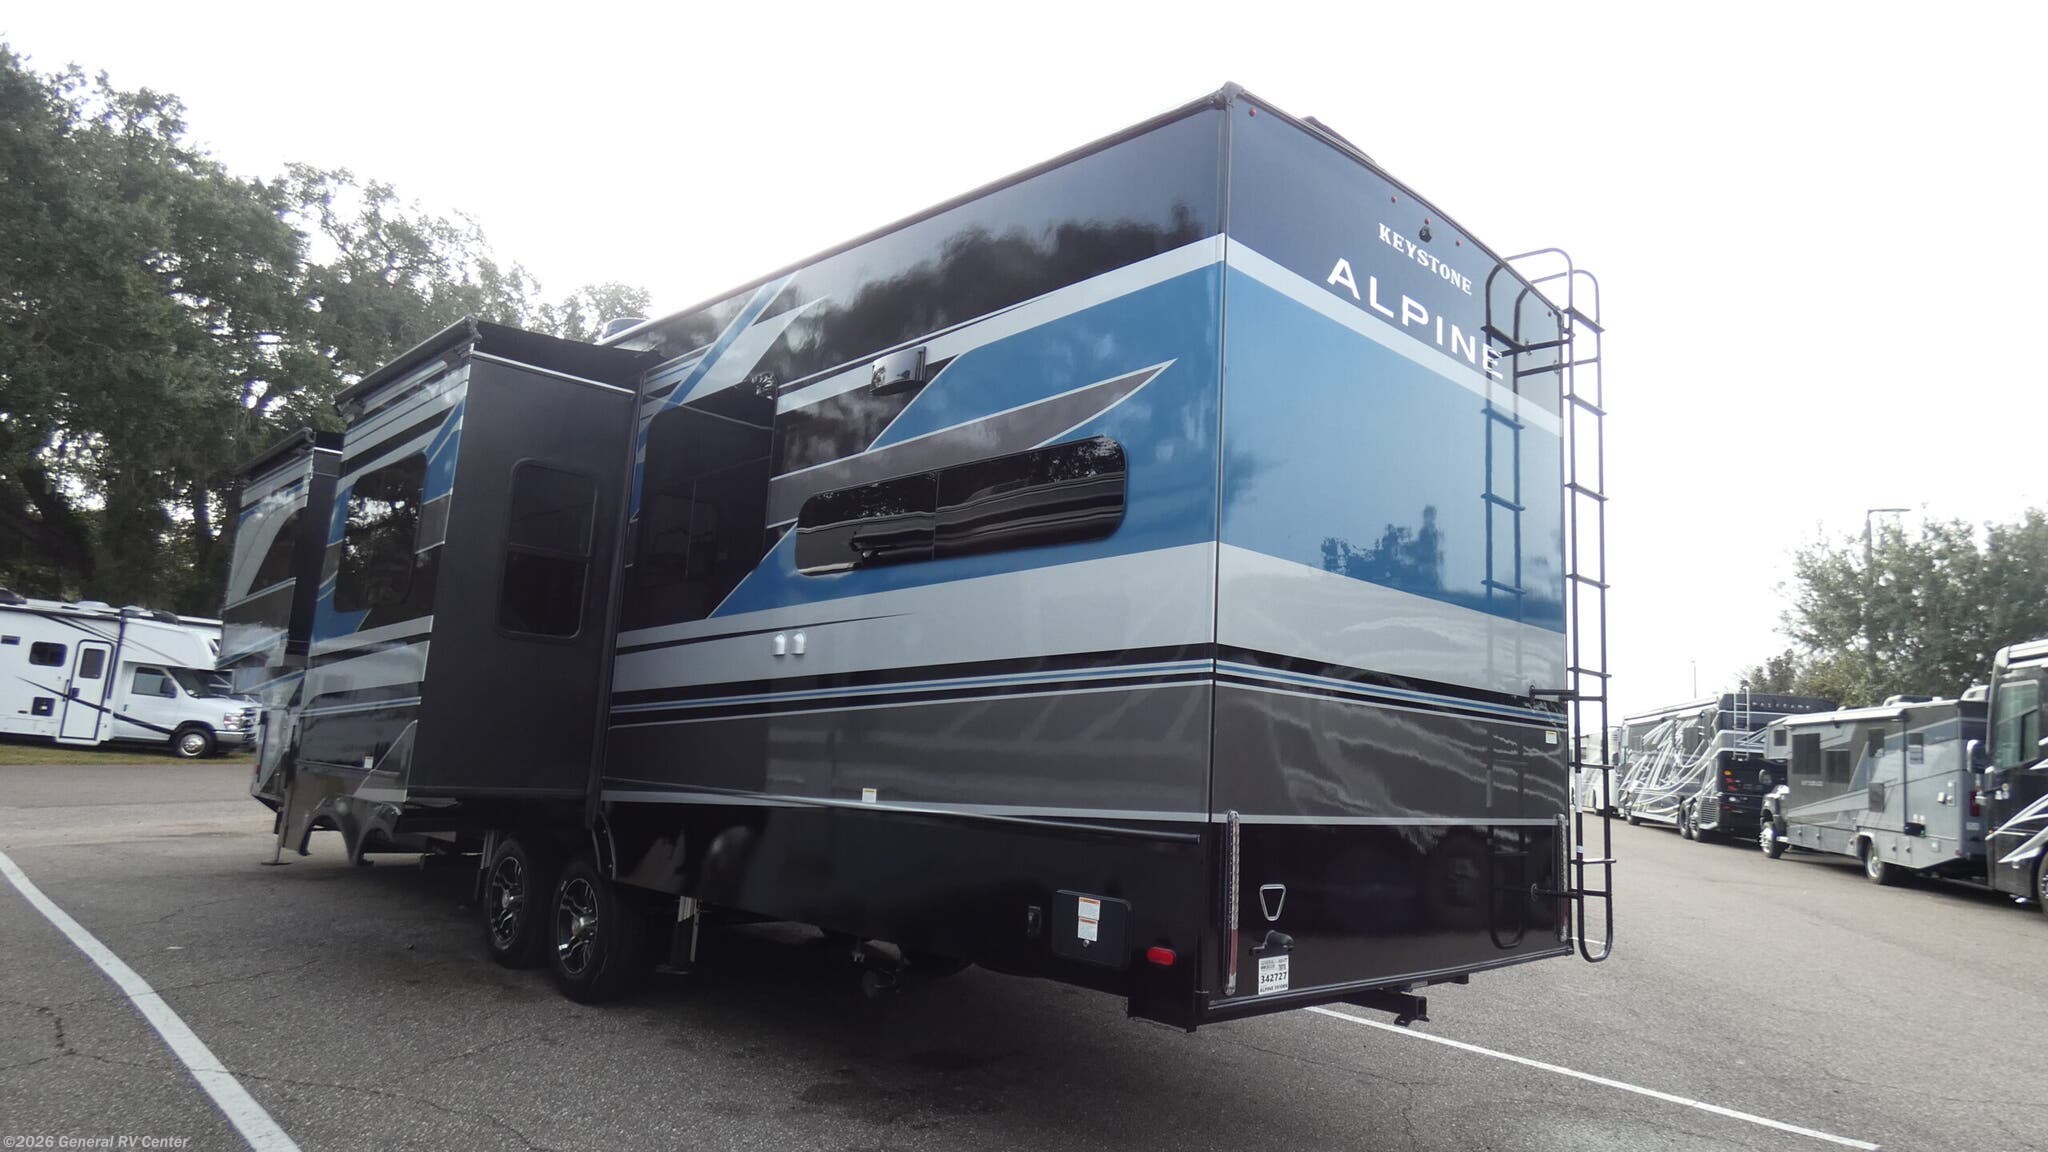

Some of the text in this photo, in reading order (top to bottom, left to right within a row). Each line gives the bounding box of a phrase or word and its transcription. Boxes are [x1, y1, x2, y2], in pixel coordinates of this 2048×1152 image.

[1378, 222, 1473, 296] KEYSTONE
[1326, 256, 1504, 380] ALPINE
[1260, 972, 1287, 984] 342727
